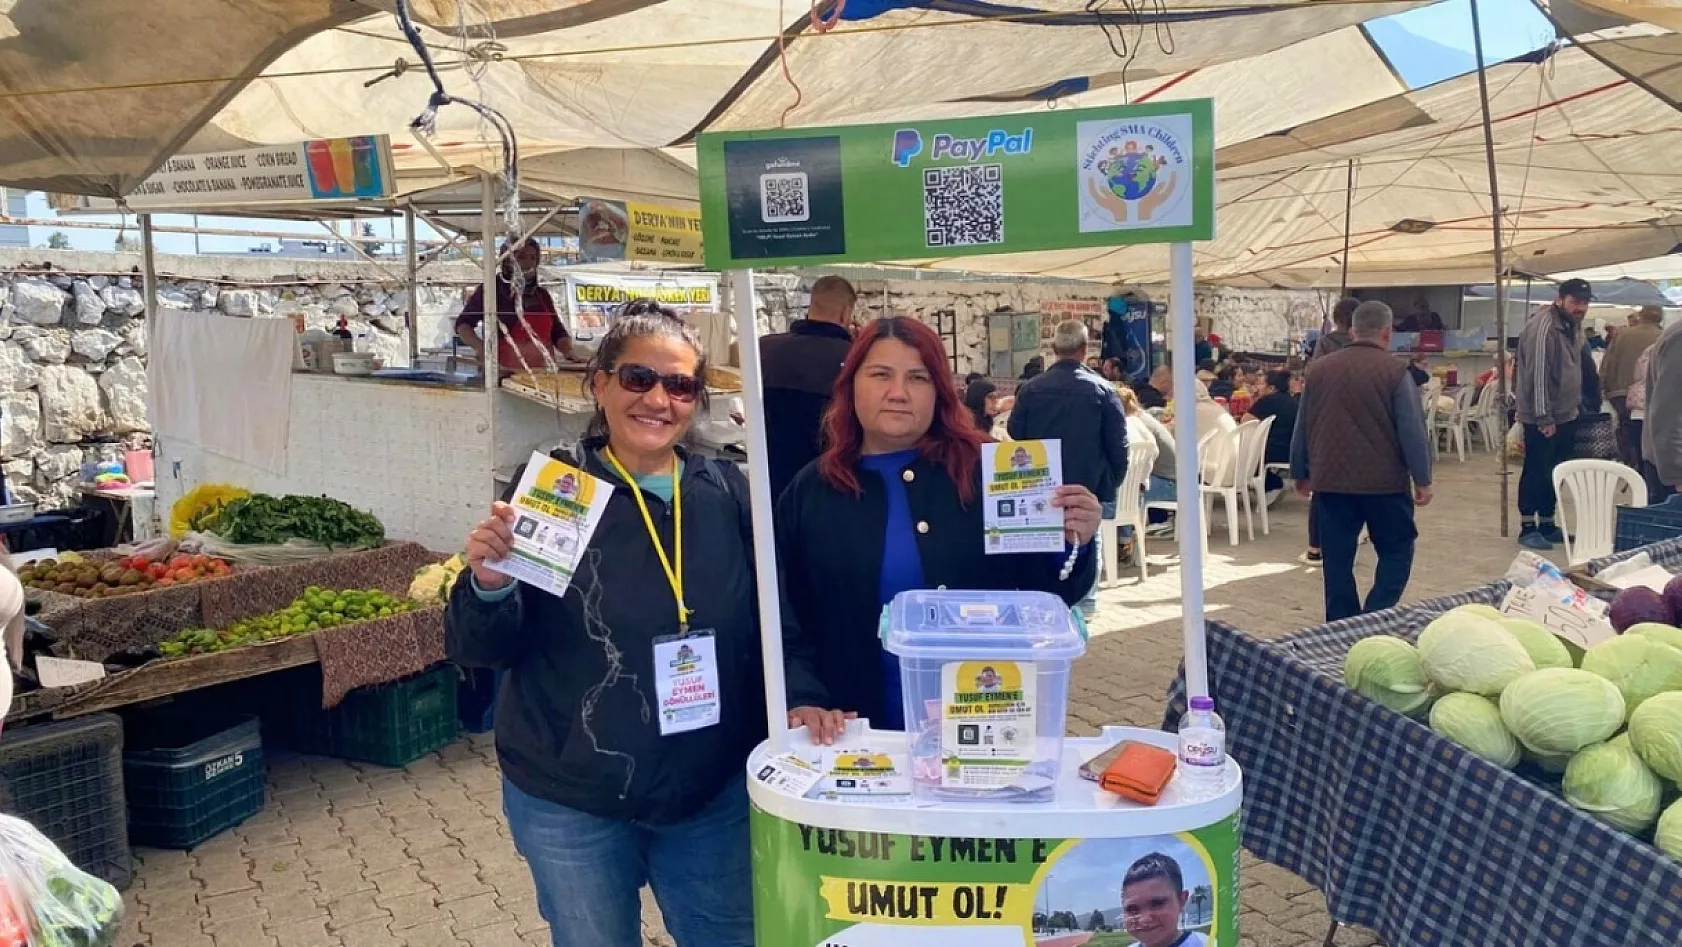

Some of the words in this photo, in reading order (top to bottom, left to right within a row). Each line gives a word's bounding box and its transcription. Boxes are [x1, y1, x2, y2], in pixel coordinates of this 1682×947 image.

[931, 127, 1033, 162] PayPal
[1083, 129, 1122, 170] Stichting
[1120, 124, 1146, 135] SMA
[1148, 126, 1183, 164] Children
[205, 155, 230, 170] ORANGE
[231, 154, 247, 169] JUICE
[275, 151, 298, 166] BREAD
[687, 217, 701, 232] YE
[672, 684, 705, 697] EYMEN
[959, 692, 981, 703] YUSUF
[949, 704, 973, 714] UMUT
[974, 704, 984, 713] OL
[234, 751, 243, 766] 5
[798, 822, 896, 861] YUSUF
[847, 881, 939, 919] UMUT
[952, 884, 1008, 920] OL!
